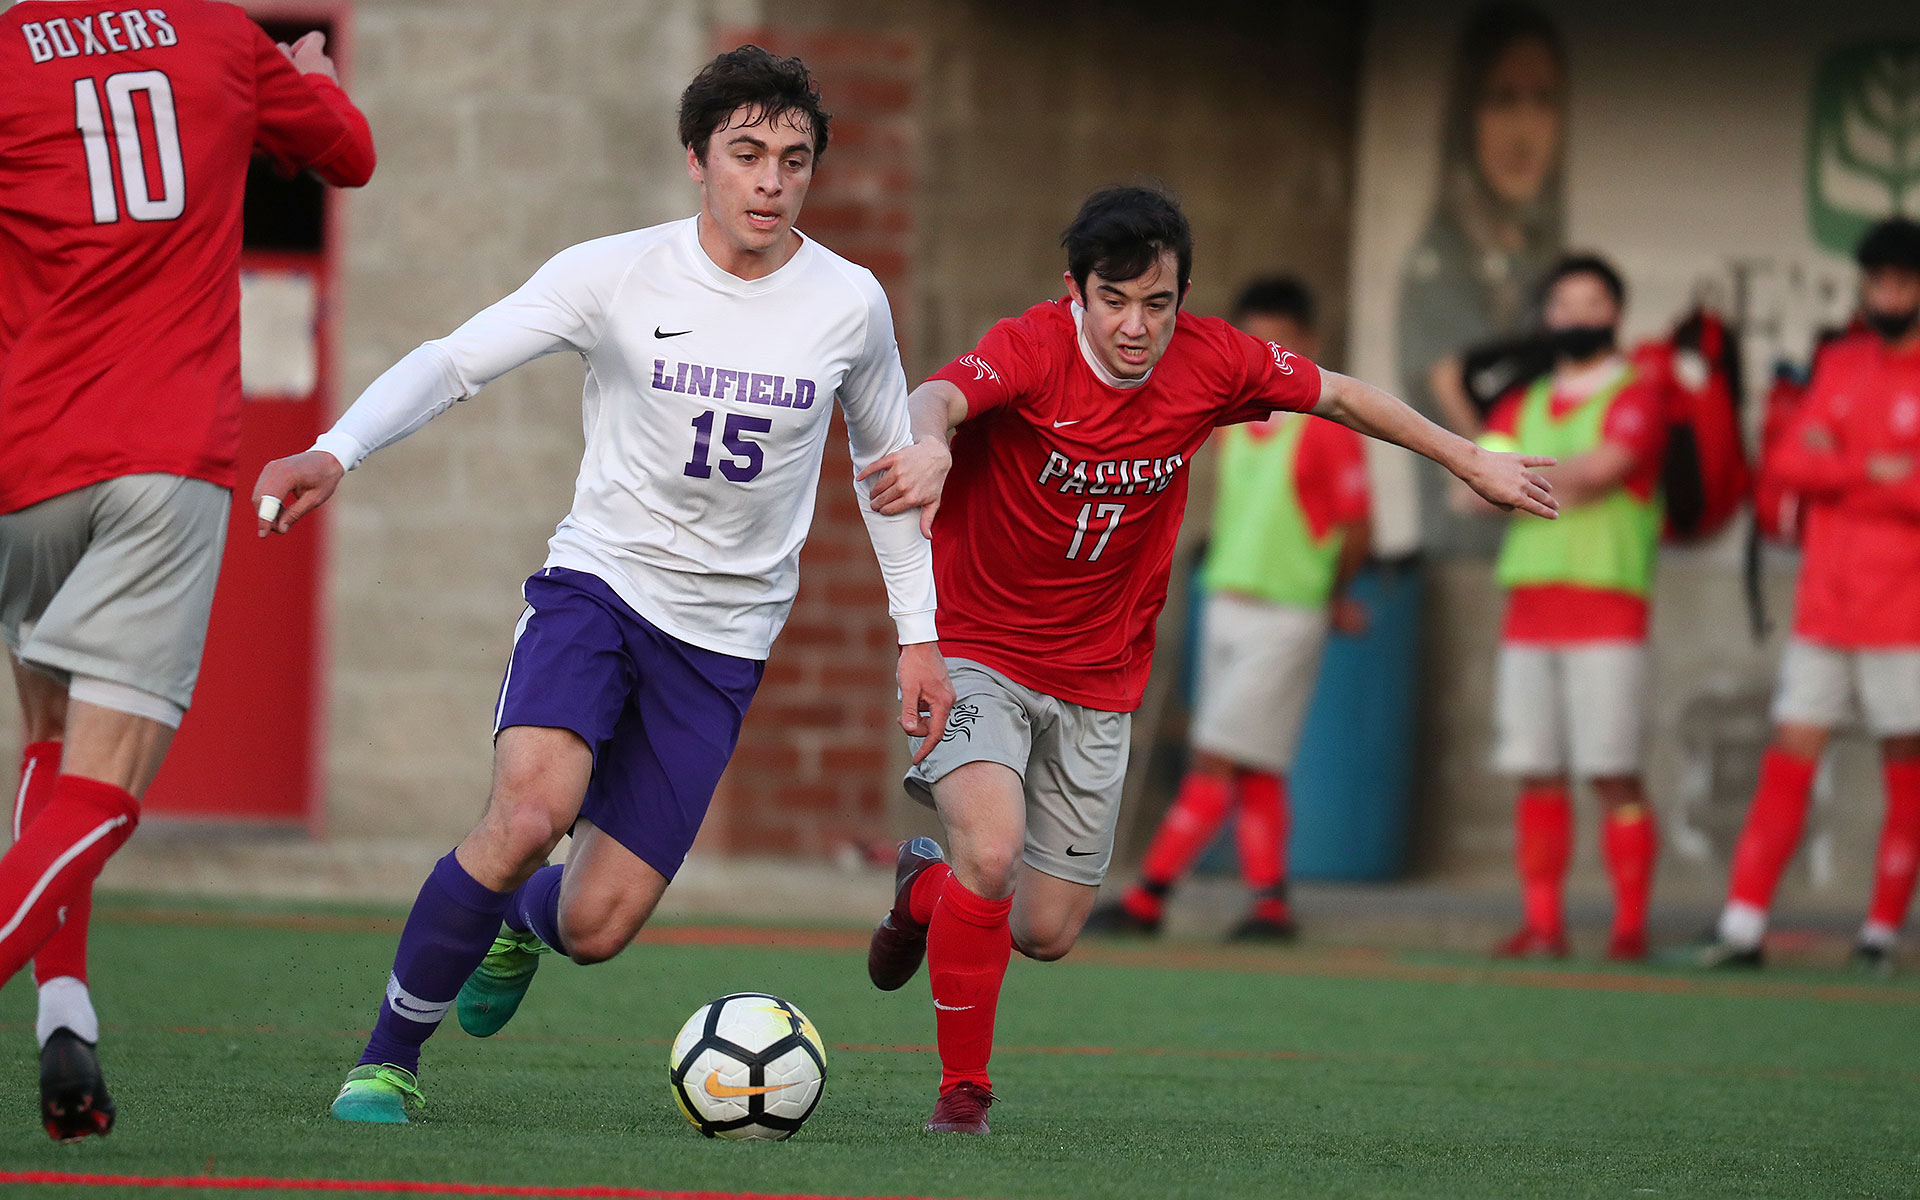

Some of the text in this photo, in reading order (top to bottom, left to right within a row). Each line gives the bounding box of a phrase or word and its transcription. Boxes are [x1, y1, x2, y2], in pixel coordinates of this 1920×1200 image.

[22, 8, 178, 63] BOXERS
[74, 70, 186, 224] 10
[651, 359, 816, 410] LINFIELD
[683, 410, 773, 482] 15
[1038, 450, 1183, 495] PACIFIC
[1065, 502, 1127, 562] 17
